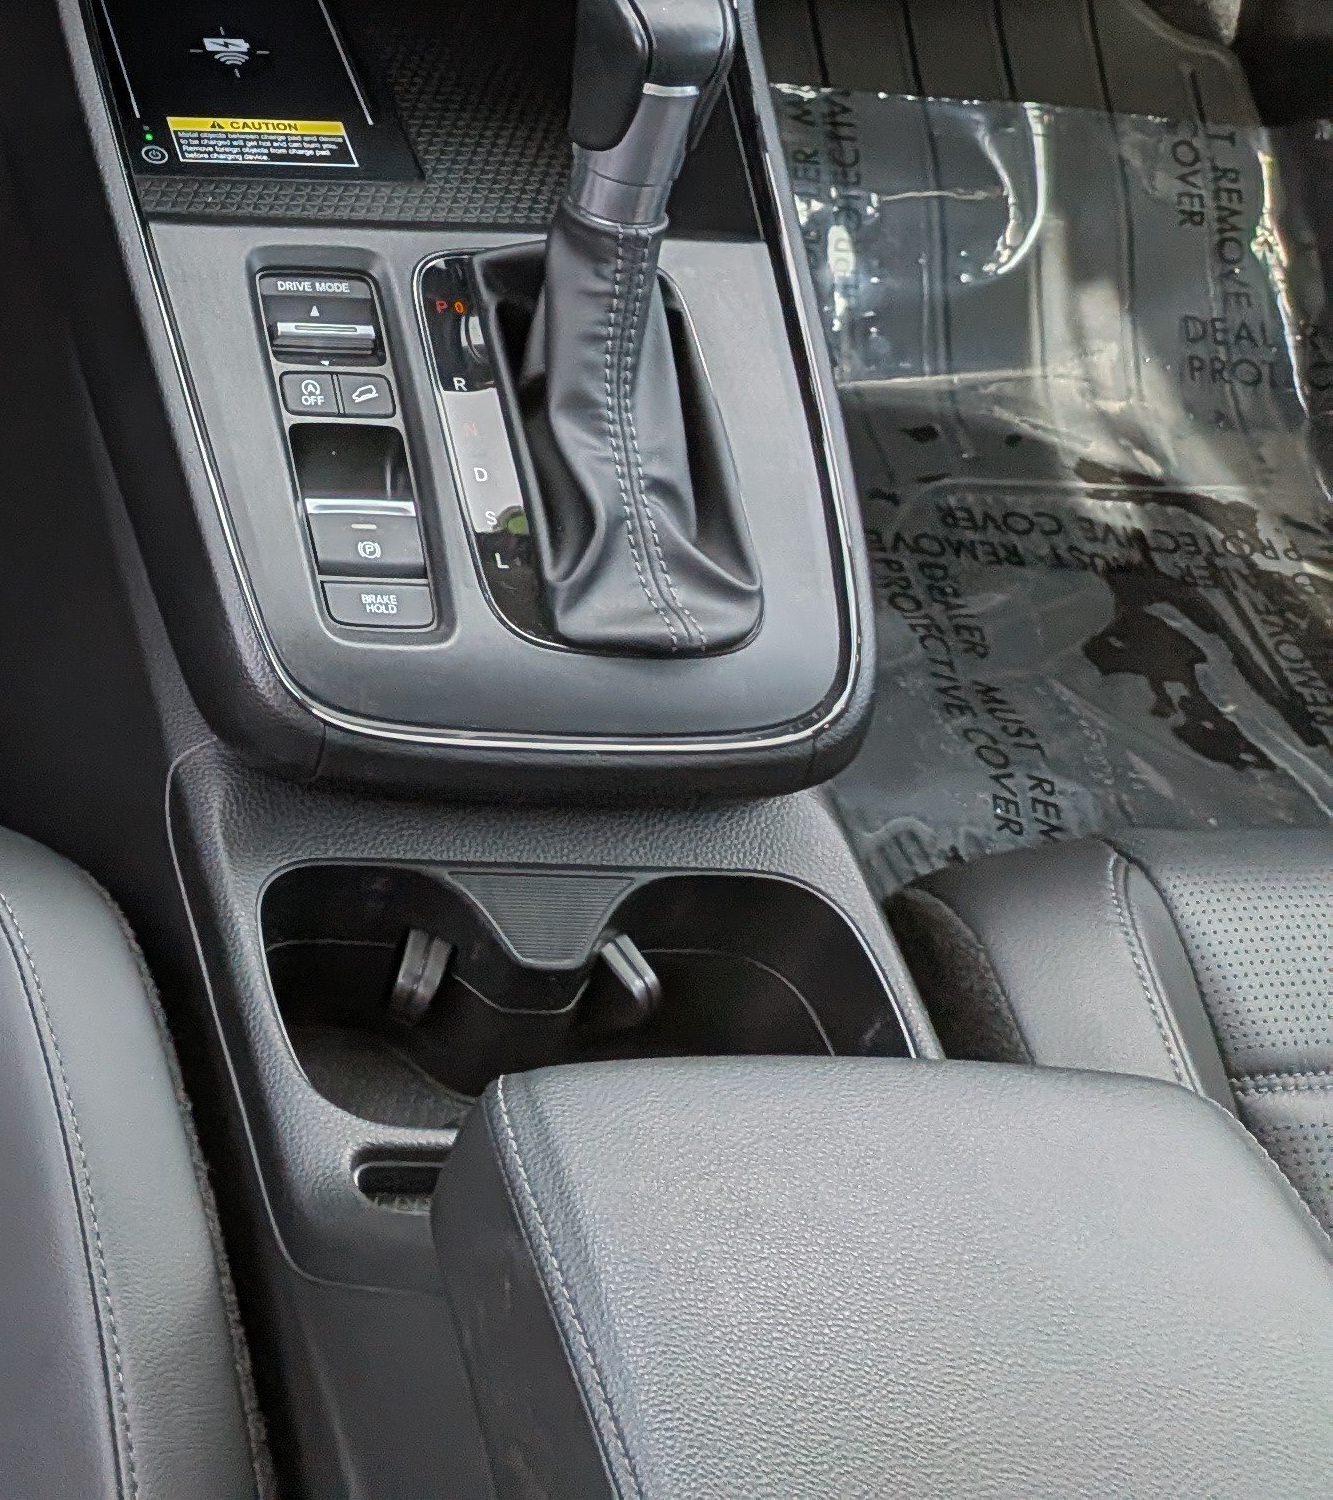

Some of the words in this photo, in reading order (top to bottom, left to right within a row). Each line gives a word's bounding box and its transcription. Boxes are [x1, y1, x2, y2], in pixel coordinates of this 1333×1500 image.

[230, 121, 299, 131] CAUTION
[183, 145, 214, 153] Remove
[214, 146, 240, 154] foreign
[209, 153, 243, 161] charging
[277, 281, 313, 291] DRIVE
[315, 282, 350, 293] MODE
[453, 377, 467, 391] R
[301, 395, 325, 405] OFF
[474, 467, 488, 482] D
[485, 510, 498, 525] S
[494, 552, 510, 569] L
[361, 593, 398, 605] BRAKE
[365, 603, 398, 614] HOLD
[961, 726, 1025, 837] COVER
